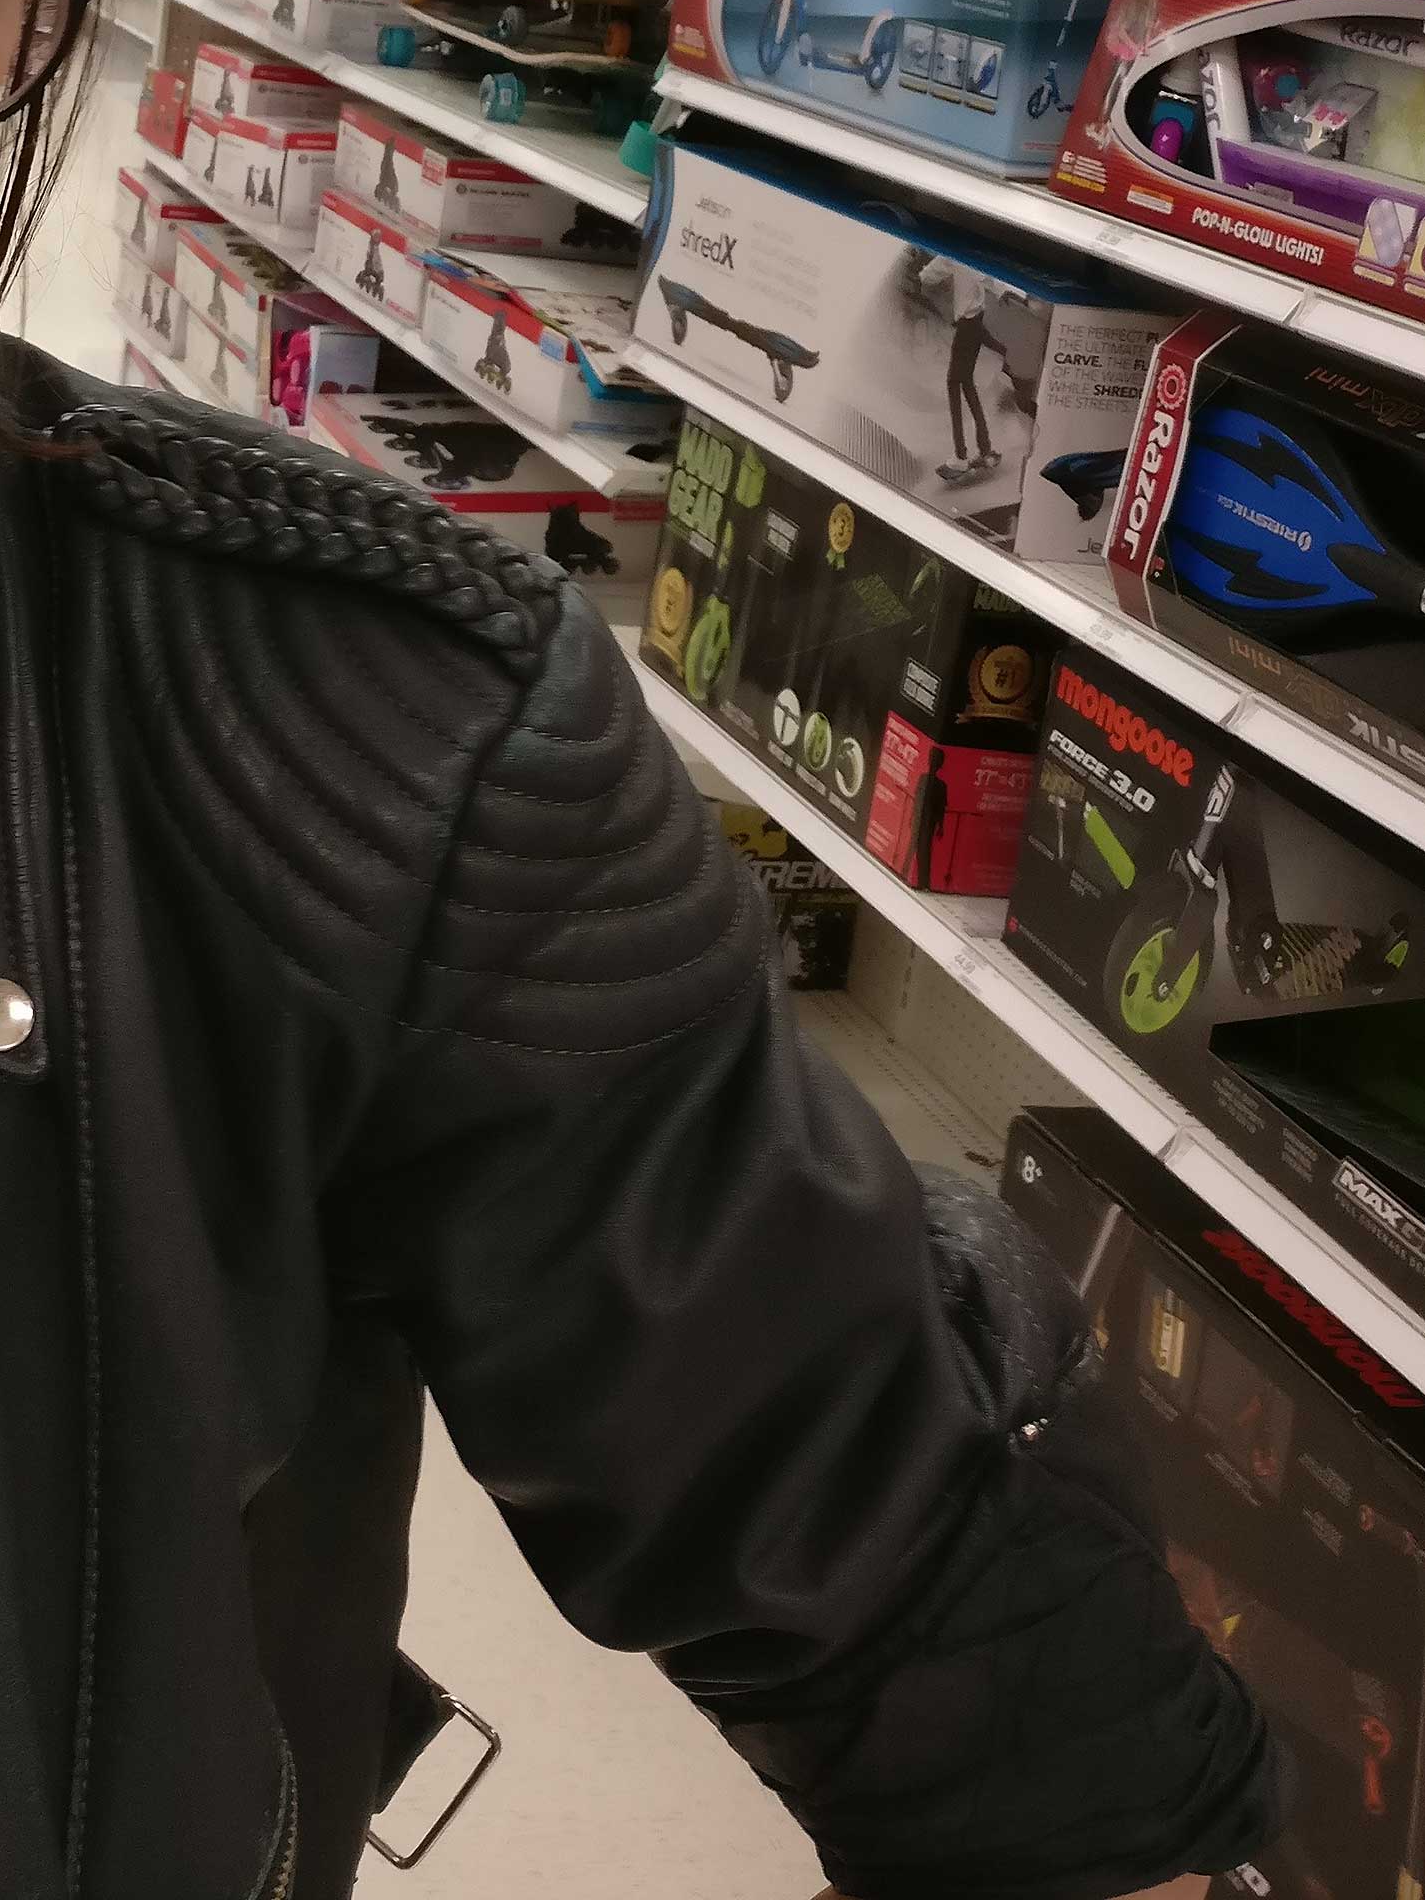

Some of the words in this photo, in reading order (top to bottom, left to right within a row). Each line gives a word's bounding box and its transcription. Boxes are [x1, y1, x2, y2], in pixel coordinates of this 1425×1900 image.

[1339, 23, 1419, 57] Razor
[680, 220, 738, 269] shredX
[1191, 206, 1273, 249] POP-N-GLOW
[1275, 232, 1325, 267] LIGHTS!
[1060, 324, 1086, 337] THE
[1054, 352, 1103, 368] CARVE.
[1304, 366, 1371, 397] mini
[1094, 384, 1142, 399] SHRED
[1124, 410, 1174, 560] Razor
[1056, 664, 1195, 788] mongoose
[1049, 729, 1110, 781] FORCE
[1109, 769, 1157, 813] 3.0
[1338, 1168, 1403, 1228] MAX
